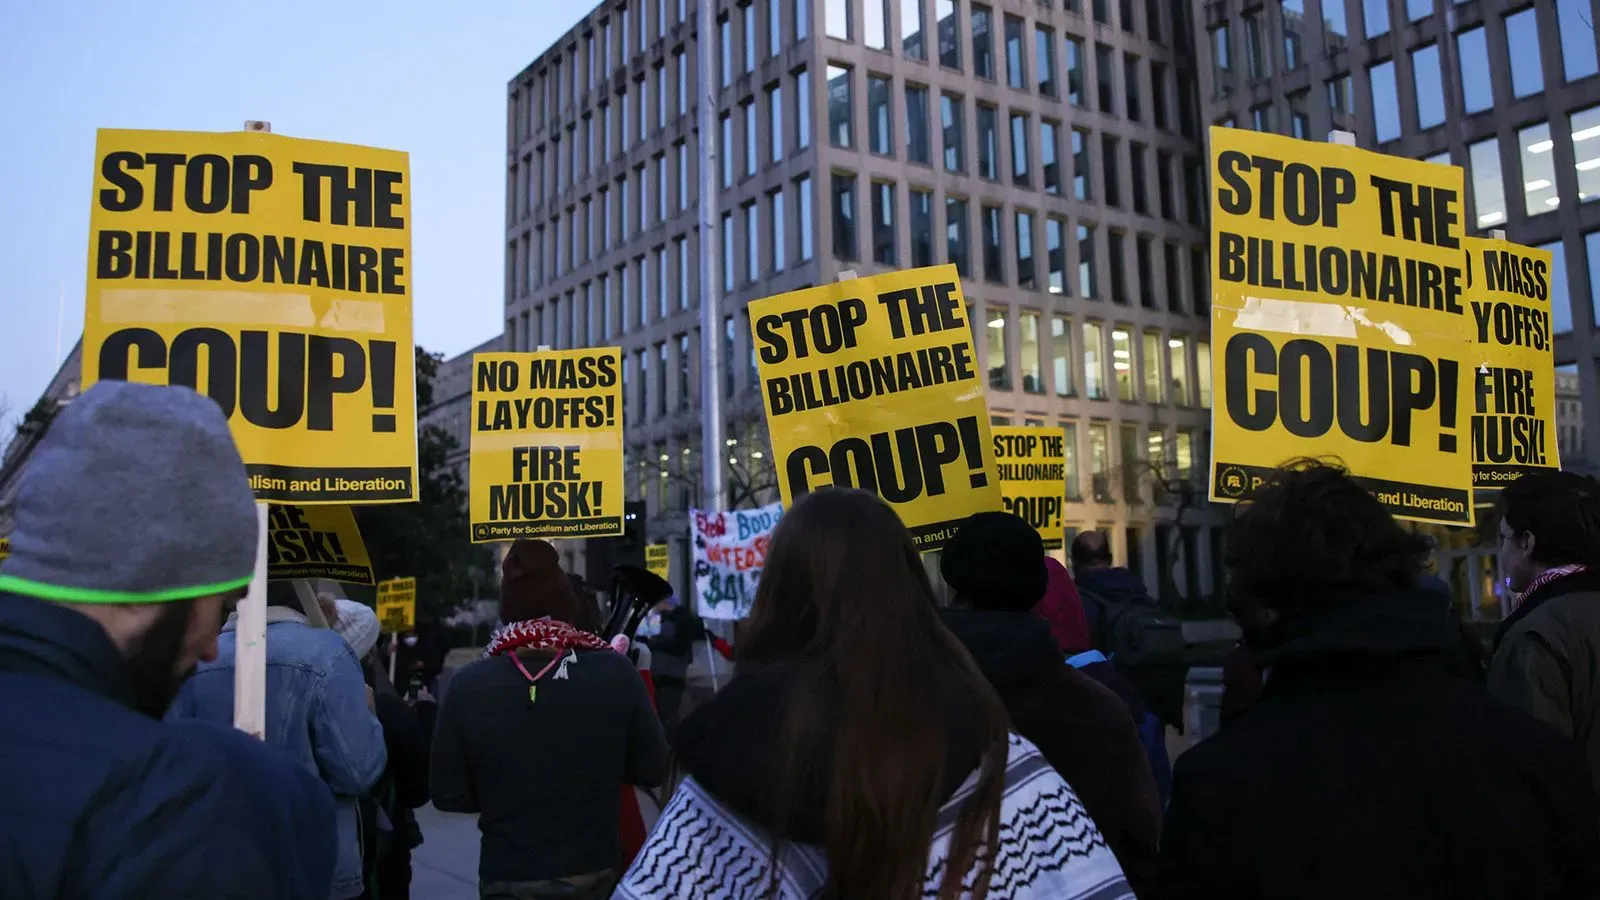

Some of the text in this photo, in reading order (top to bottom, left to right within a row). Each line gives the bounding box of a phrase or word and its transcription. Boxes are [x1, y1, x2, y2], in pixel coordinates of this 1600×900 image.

[100, 151, 404, 230] STOP THE
[1217, 150, 1460, 250] STOP THE
[96, 231, 405, 295] BILLIONAIRE
[1219, 231, 1463, 315] BILLIONAIRE
[1483, 250, 1548, 302] MASS
[755, 282, 965, 365] STOP THE
[1471, 301, 1550, 352] YOFFS!
[477, 355, 617, 392] NO MASS
[766, 342, 976, 416] BILLIONAIRE
[1225, 332, 1459, 454] COUP!
[1475, 367, 1535, 416] FIRE
[477, 395, 615, 431] LAYOFFS!
[512, 445, 581, 482] FIRE
[993, 434, 1063, 458] STOP THE
[290, 479, 321, 491] and
[325, 478, 405, 491] Liberation
[1479, 471, 1490, 480] for
[489, 481, 603, 520] MUSK!
[1377, 491, 1464, 513] and Liberation
[491, 526, 511, 536] Party
[525, 525, 562, 534] Socialism
[564, 524, 578, 532] and
[579, 522, 618, 531] Liberation
[924, 530, 945, 543] and
